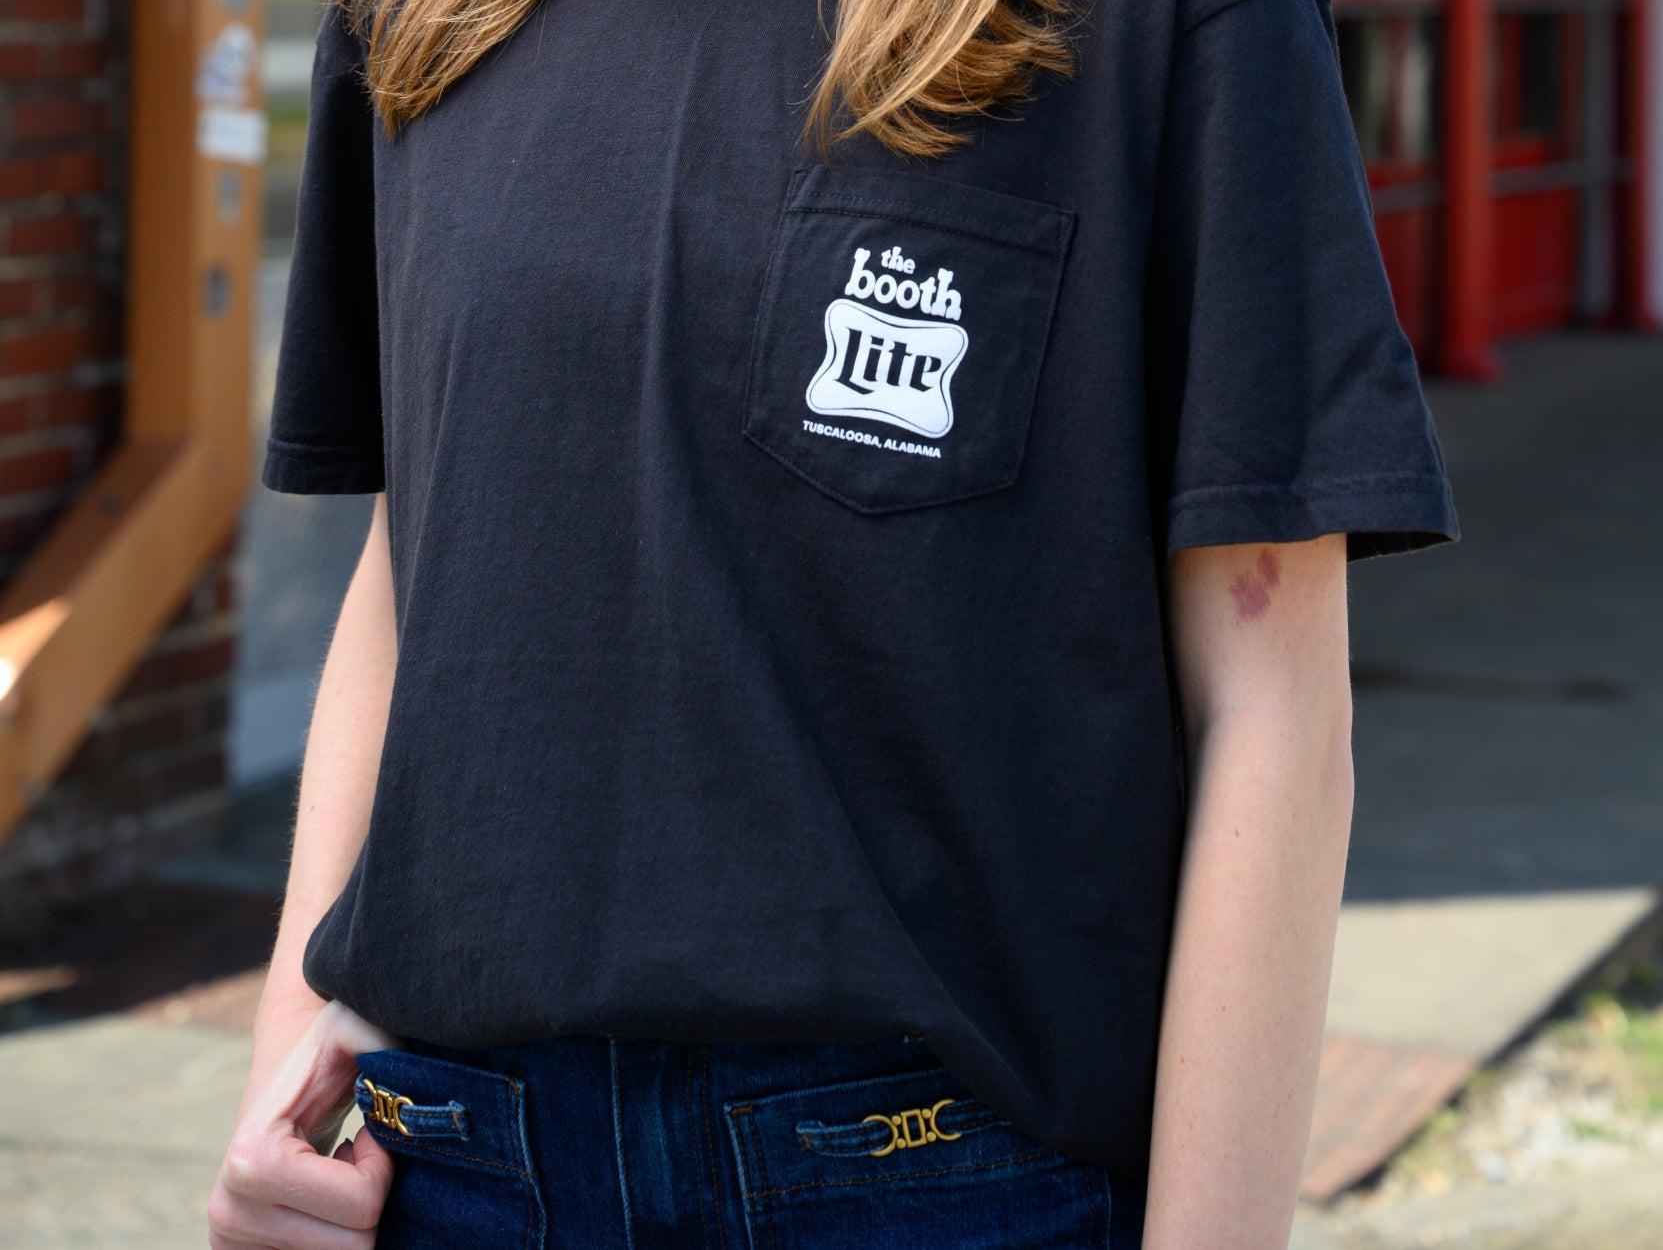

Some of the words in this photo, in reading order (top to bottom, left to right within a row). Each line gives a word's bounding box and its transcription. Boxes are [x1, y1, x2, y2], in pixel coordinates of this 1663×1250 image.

[844, 247, 962, 321] booth
[880, 246, 916, 274] the
[833, 326, 943, 395] Lite
[803, 419, 882, 449] TUSCALOOSA,
[883, 438, 942, 459] ALABAMA
